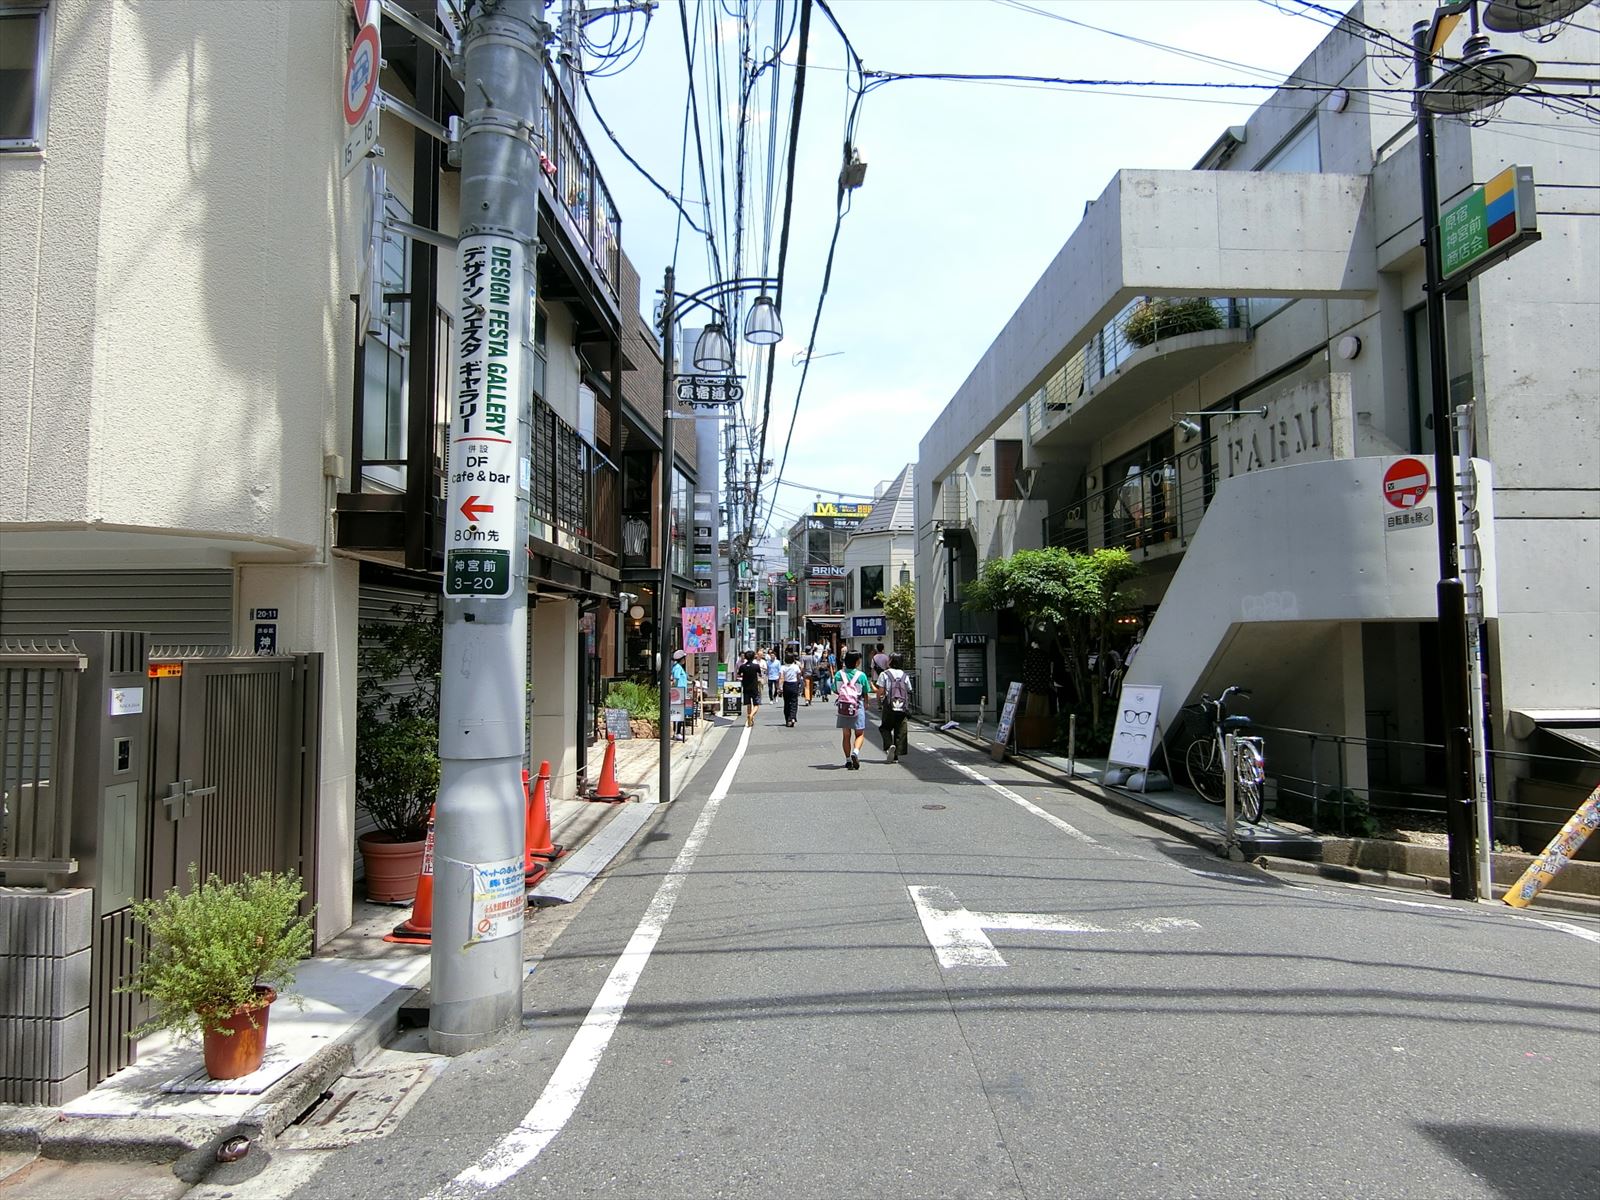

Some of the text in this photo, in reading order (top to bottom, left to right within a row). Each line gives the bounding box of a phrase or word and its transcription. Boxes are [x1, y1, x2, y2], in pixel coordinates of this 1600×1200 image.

[486, 246, 511, 436] DESIGN FESTA GALLERY
[680, 385, 742, 400] 原宿通り
[468, 445, 489, 453] 併設
[466, 456, 488, 468] DF
[451, 470, 511, 484] cafe & bar
[454, 560, 496, 573] 神宮前
[454, 577, 494, 589] 3-20
[957, 635, 986, 644] FARM
